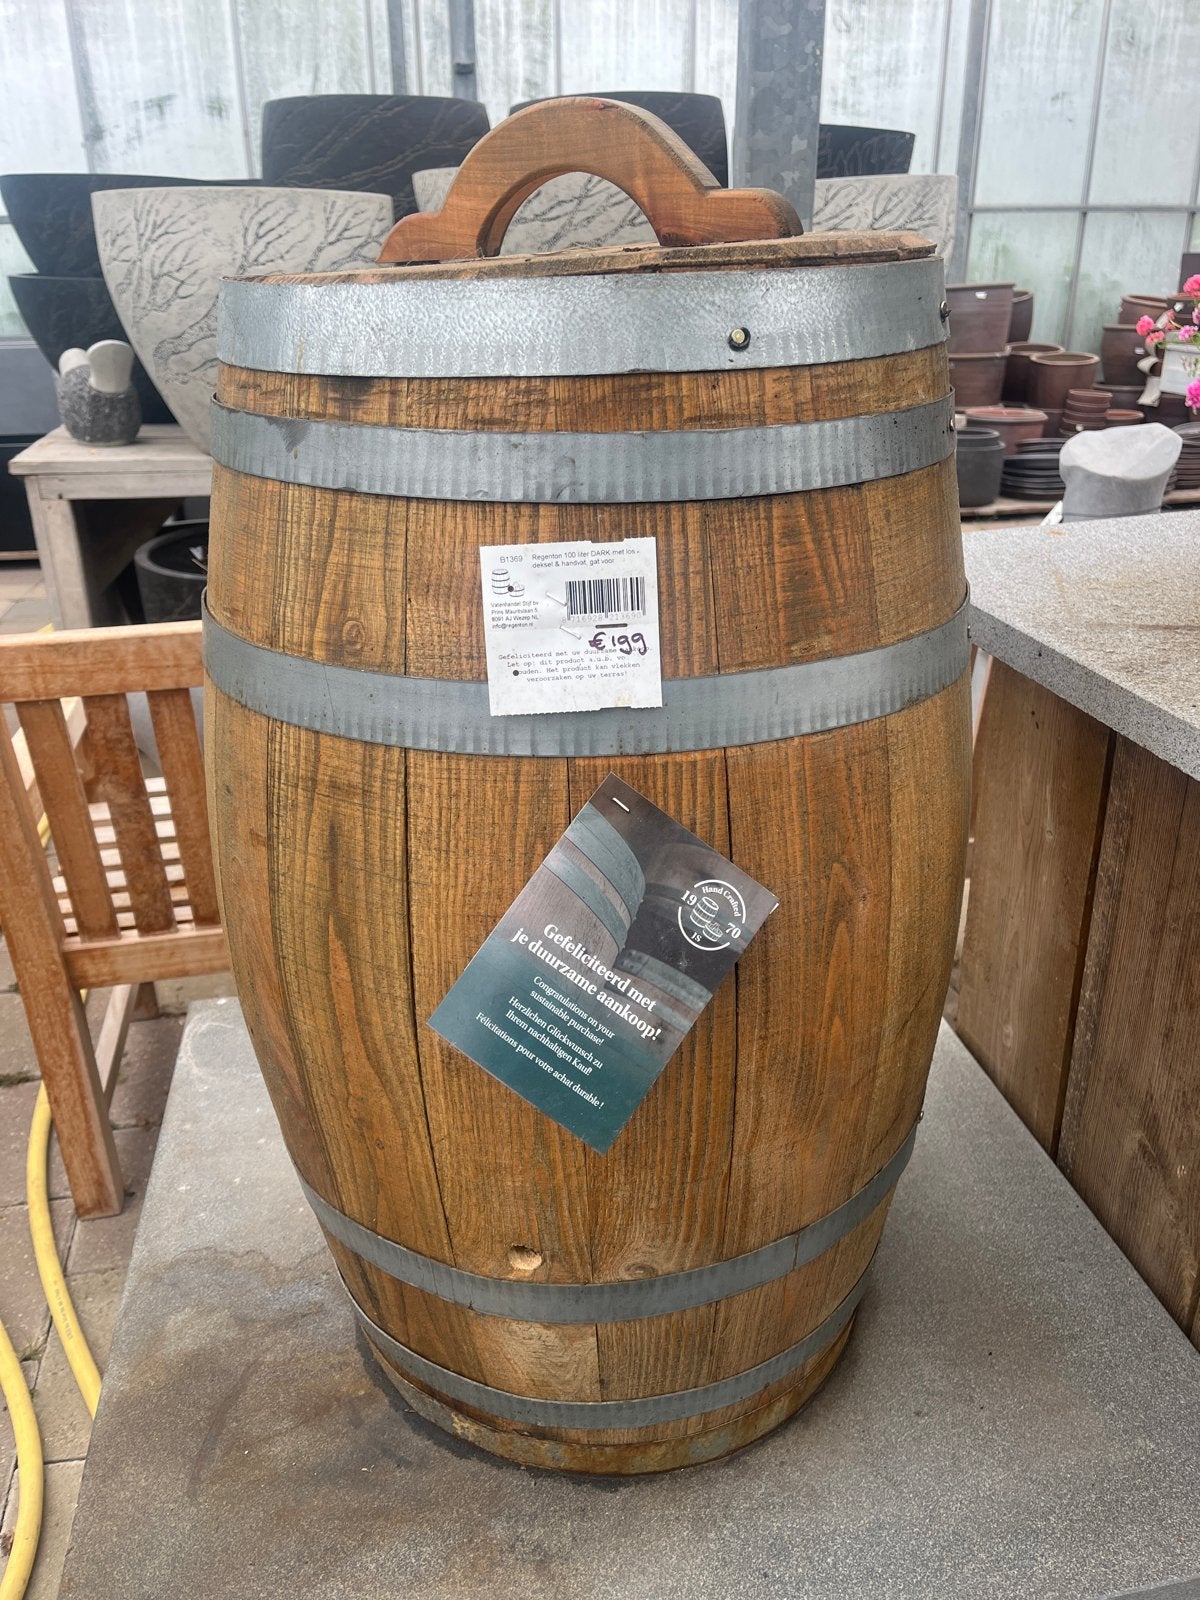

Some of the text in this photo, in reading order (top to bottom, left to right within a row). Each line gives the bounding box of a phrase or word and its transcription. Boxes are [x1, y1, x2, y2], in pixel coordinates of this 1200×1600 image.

[500, 555, 523, 564] B1369
[532, 553, 562, 562] Regenton
[577, 551, 590, 559] liter
[590, 549, 611, 557] DARK
[532, 560, 553, 569] deksel
[571, 614, 603, 623] 716928
[498, 651, 552, 660] Gefeliciteerd
[523, 660, 536, 668] op:
[539, 658, 552, 666] dit
[555, 657, 585, 665] product
[588, 655, 613, 663] a.u.b.
[516, 668, 542, 676] ouden.
[562, 665, 592, 674] product
[611, 662, 641, 670] vlekken
[526, 674, 572, 683] veroorzaken
[575, 673, 585, 681] op
[600, 670, 628, 678] terras!
[681, 890, 698, 906] 19
[702, 885, 742, 917] Hand Crafted
[725, 922, 741, 939] 70
[543, 924, 657, 1012] Gefeliciteerd met
[510, 928, 662, 1041] je duurzame aankoop!
[533, 976, 616, 1039] Congratulations on your
[529, 990, 605, 1046] sustainable purchase!
[505, 1009, 529, 1031] Ihrem
[527, 1027, 573, 1062] nachhaltigen
[508, 996, 603, 1070] Herzlichen Glückwunsch zu
[475, 1012, 518, 1048] Félicitations
[515, 1044, 536, 1060] pour
[535, 1056, 554, 1074] votre
[552, 1069, 574, 1089] achat
[572, 1083, 600, 1108] durable
